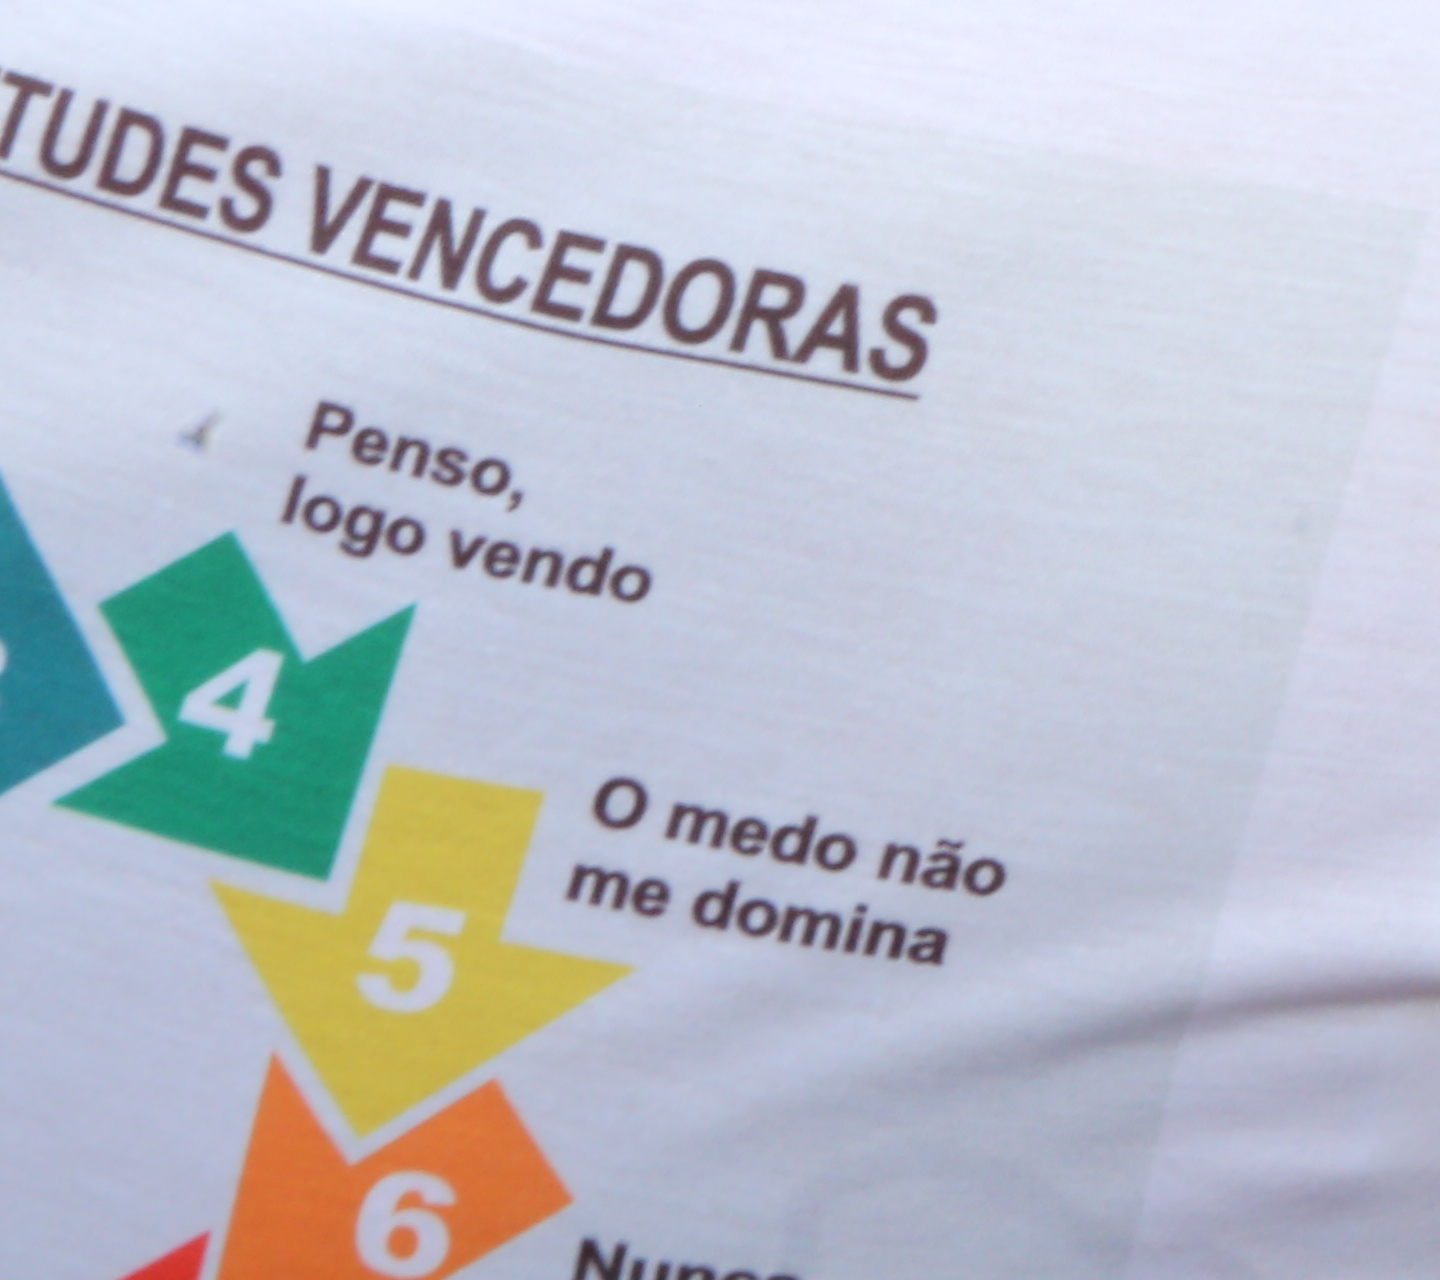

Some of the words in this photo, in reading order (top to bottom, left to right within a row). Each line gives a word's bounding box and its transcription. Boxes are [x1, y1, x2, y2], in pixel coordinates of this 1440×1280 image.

[0, 65, 281, 234] TUDES
[310, 165, 938, 383] VENCEDORAS
[304, 400, 524, 513] Penso,
[280, 472, 427, 558] logo
[449, 528, 653, 604] vendo
[177, 647, 286, 760] 4
[592, 776, 648, 830] O
[664, 815, 857, 873] medo
[876, 839, 1008, 897] não
[355, 899, 469, 1014] 5
[565, 862, 671, 918] me
[691, 880, 951, 966] domina
[354, 1169, 458, 1280] 6
